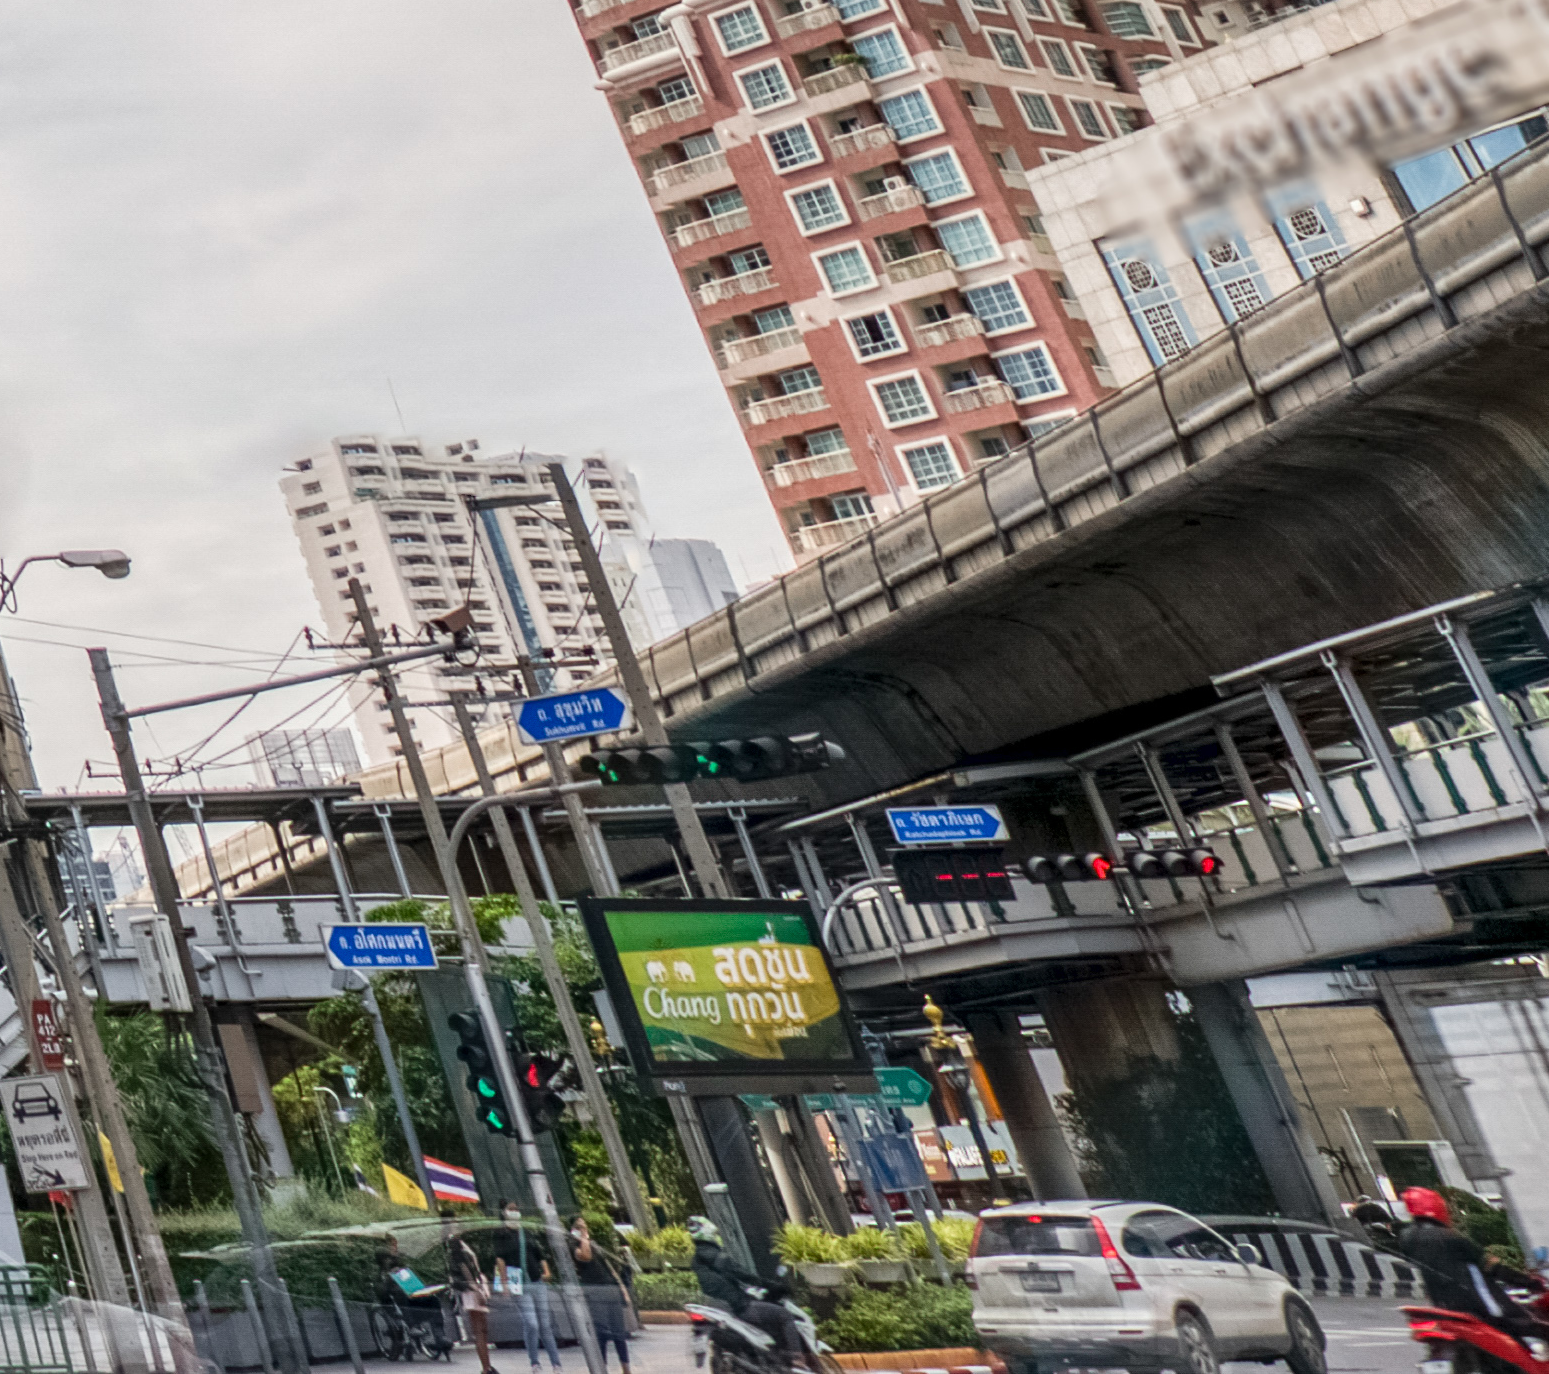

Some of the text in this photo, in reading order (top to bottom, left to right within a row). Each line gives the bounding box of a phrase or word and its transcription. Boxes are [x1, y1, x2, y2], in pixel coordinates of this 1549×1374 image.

[554, 694, 603, 723] สุขุมวิท
[353, 927, 424, 950] อโศกมนตรี
[37, 1014, 52, 1025] PA
[643, 986, 722, 1025] Chang
[725, 982, 807, 1039] ทุกวัน
